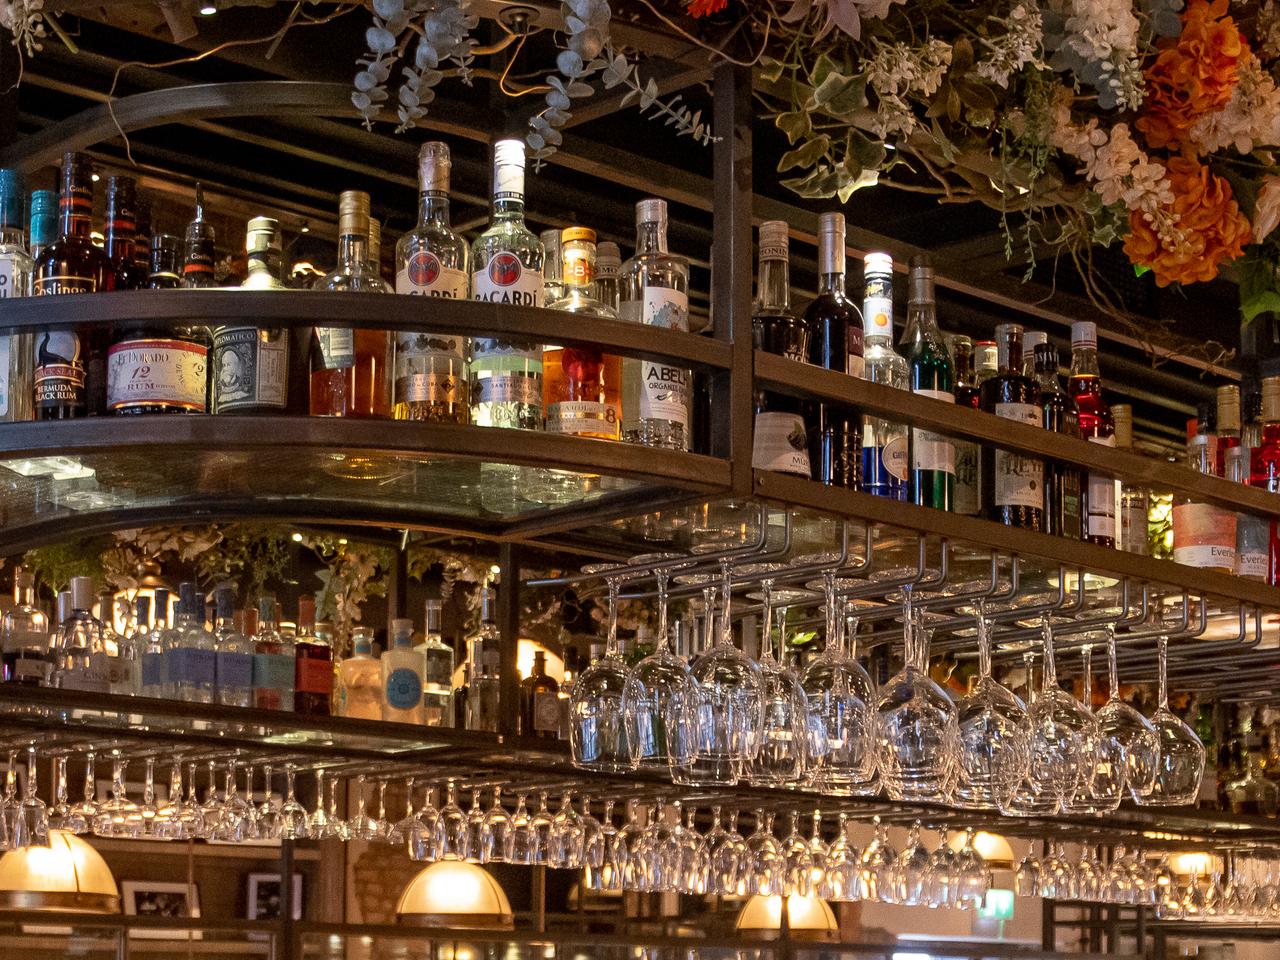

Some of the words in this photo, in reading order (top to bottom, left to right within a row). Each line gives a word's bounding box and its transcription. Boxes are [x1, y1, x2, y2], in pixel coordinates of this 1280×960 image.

[132, 366, 150, 379] 12
[37, 384, 72, 393] BERMUDA
[57, 391, 77, 400] RUM
[605, 408, 616, 424] 8
